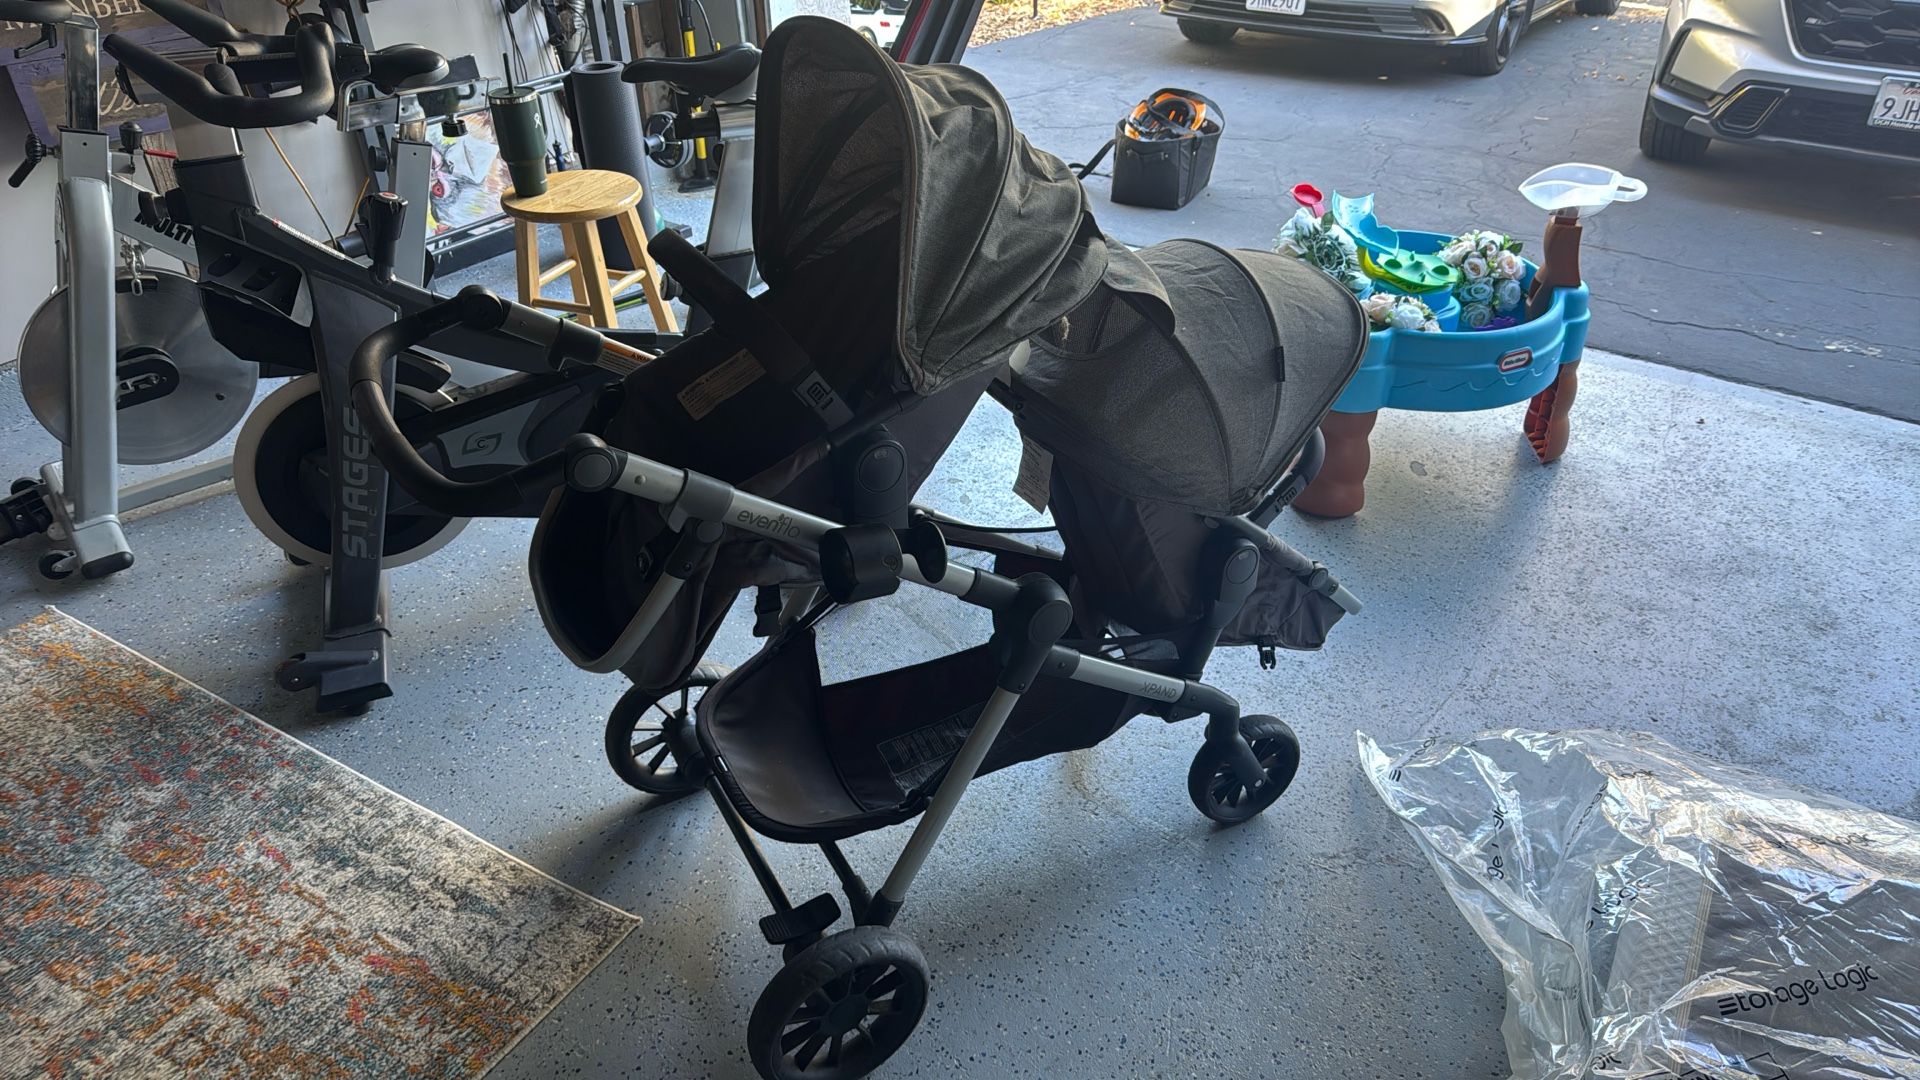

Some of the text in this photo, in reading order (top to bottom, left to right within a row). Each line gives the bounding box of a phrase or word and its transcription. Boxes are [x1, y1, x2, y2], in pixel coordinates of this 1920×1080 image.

[737, 509, 800, 538] evenflo
[1142, 681, 1177, 698] XPAND
[1817, 962, 1878, 992] Logic
